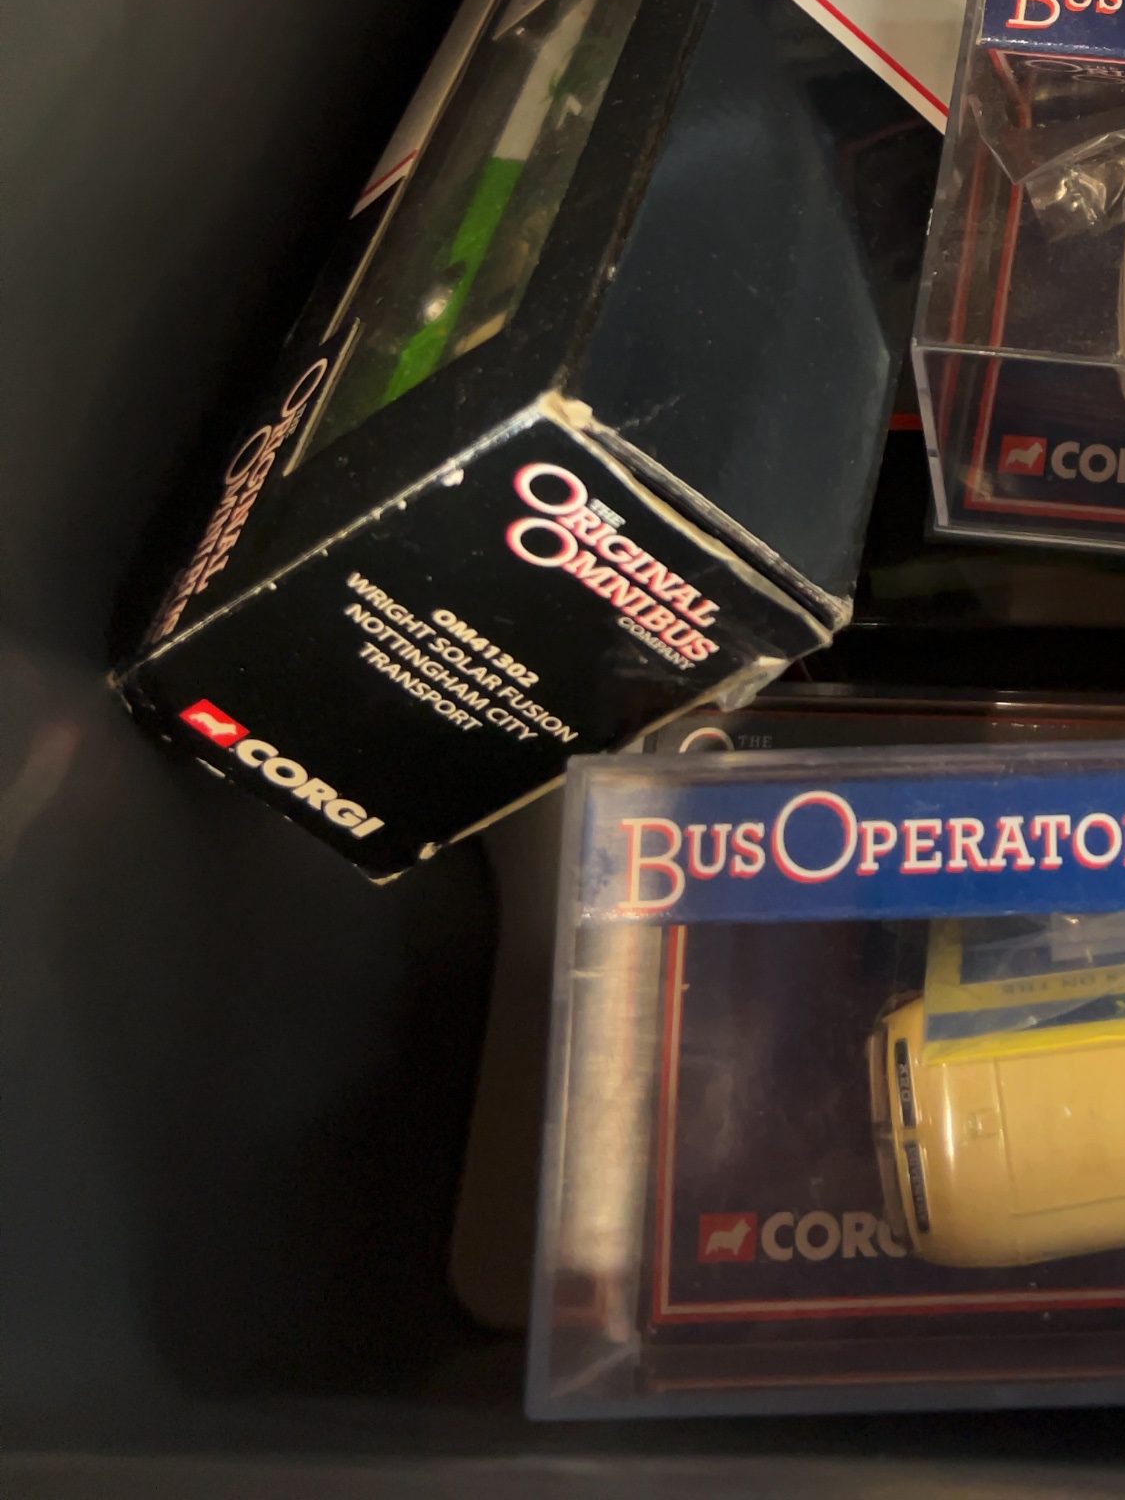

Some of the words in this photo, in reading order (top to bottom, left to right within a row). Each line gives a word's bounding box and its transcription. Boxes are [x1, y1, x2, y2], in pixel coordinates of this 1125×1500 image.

[513, 462, 721, 628] ORIGINAL
[588, 498, 626, 528] THE
[506, 517, 720, 661] OMNIBUS
[344, 603, 491, 711] NOTTINGHAM
[485, 707, 539, 741] CITY
[346, 571, 436, 640] WRIGHT
[428, 636, 502, 691] SOLAR
[498, 685, 579, 743] FUSION
[358, 641, 484, 731] TRANSPORT
[432, 608, 540, 689] OM41302
[617, 615, 695, 671] COMPANY
[235, 738, 386, 840] CORGI
[738, 734, 773, 749] THE
[616, 817, 766, 915] BUS
